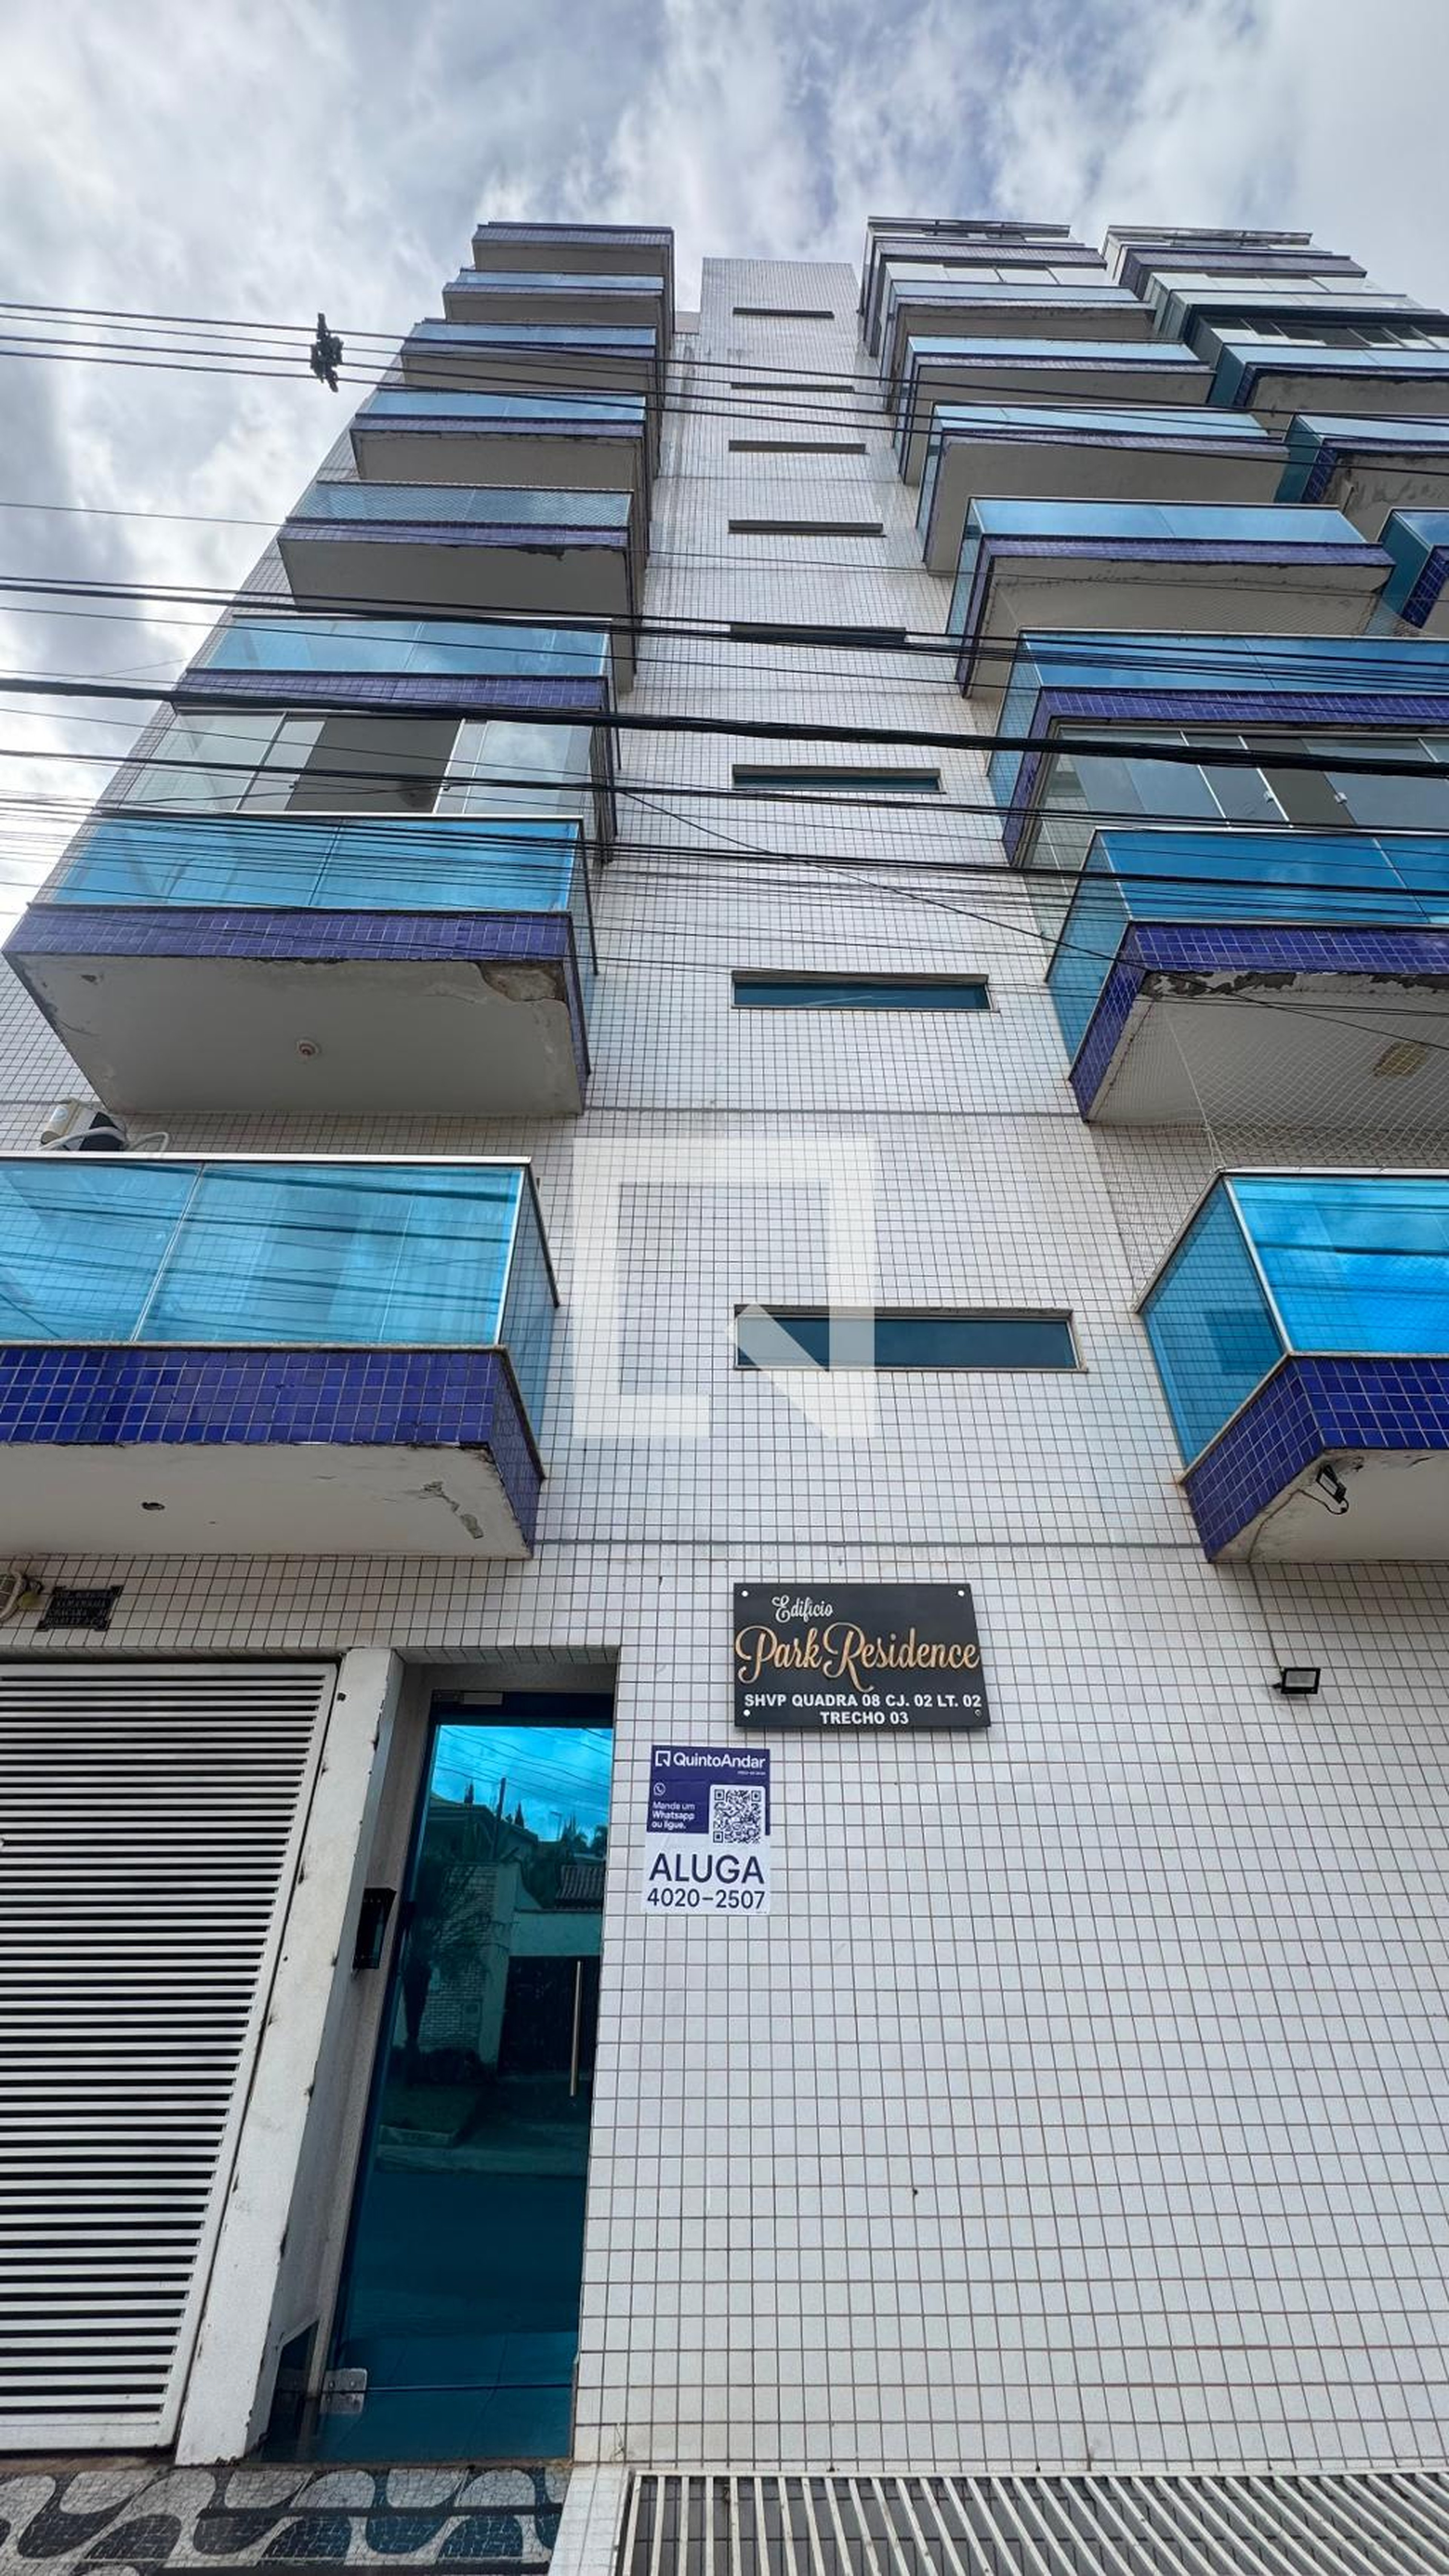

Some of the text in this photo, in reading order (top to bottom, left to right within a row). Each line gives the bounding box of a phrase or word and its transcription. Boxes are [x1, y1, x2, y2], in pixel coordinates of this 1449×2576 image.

[735, 1622, 980, 1692] Park Residence
[744, 1694, 981, 1707] SHVP QUADRA 08 CJ. 02 LT. 02
[820, 1712, 909, 1724] TRECHO 03
[674, 1752, 766, 1768] QuintoAndar
[653, 1811, 695, 1821] Whatsapp
[649, 1853, 764, 1884] ALUGA
[647, 1888, 765, 1909] 4020-2507
